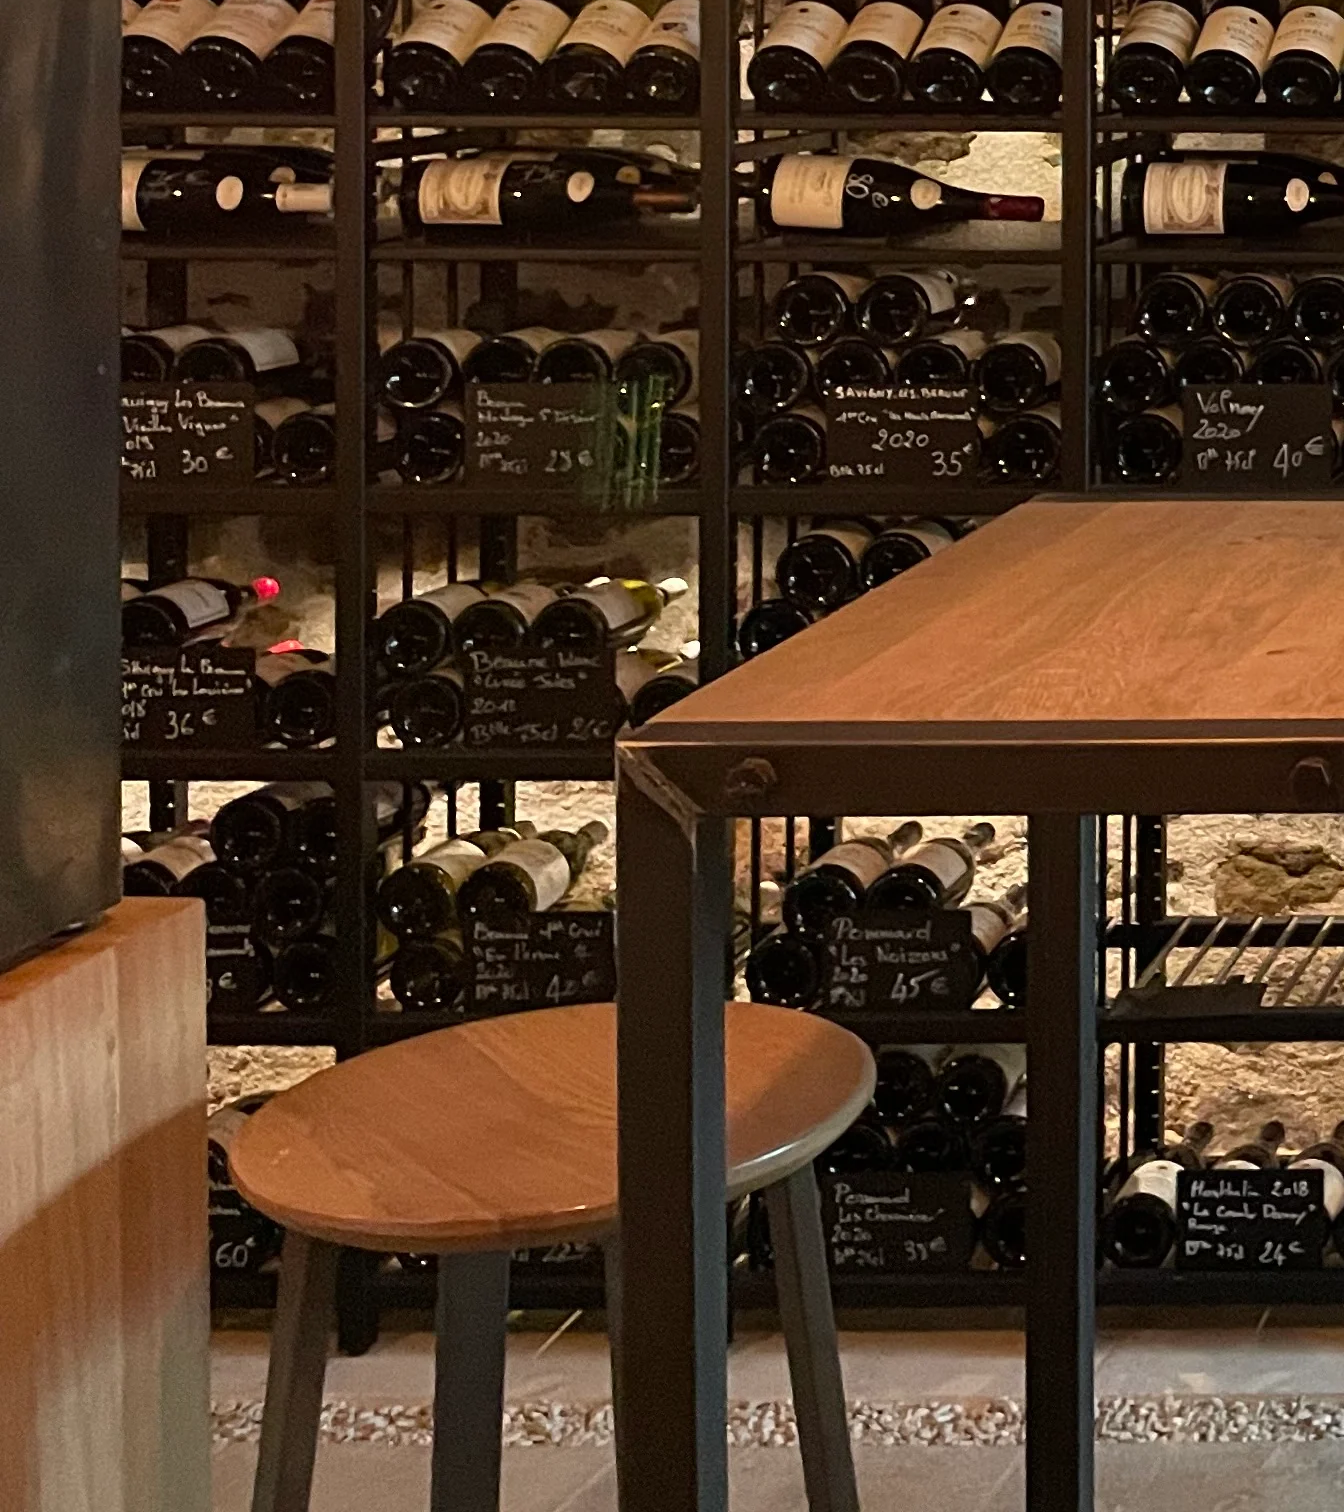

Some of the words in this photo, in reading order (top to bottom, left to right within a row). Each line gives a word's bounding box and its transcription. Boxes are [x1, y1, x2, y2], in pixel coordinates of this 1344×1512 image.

[1196, 389, 1265, 433] Volnay
[871, 428, 929, 452] 2020
[1192, 418, 1242, 439] 2020
